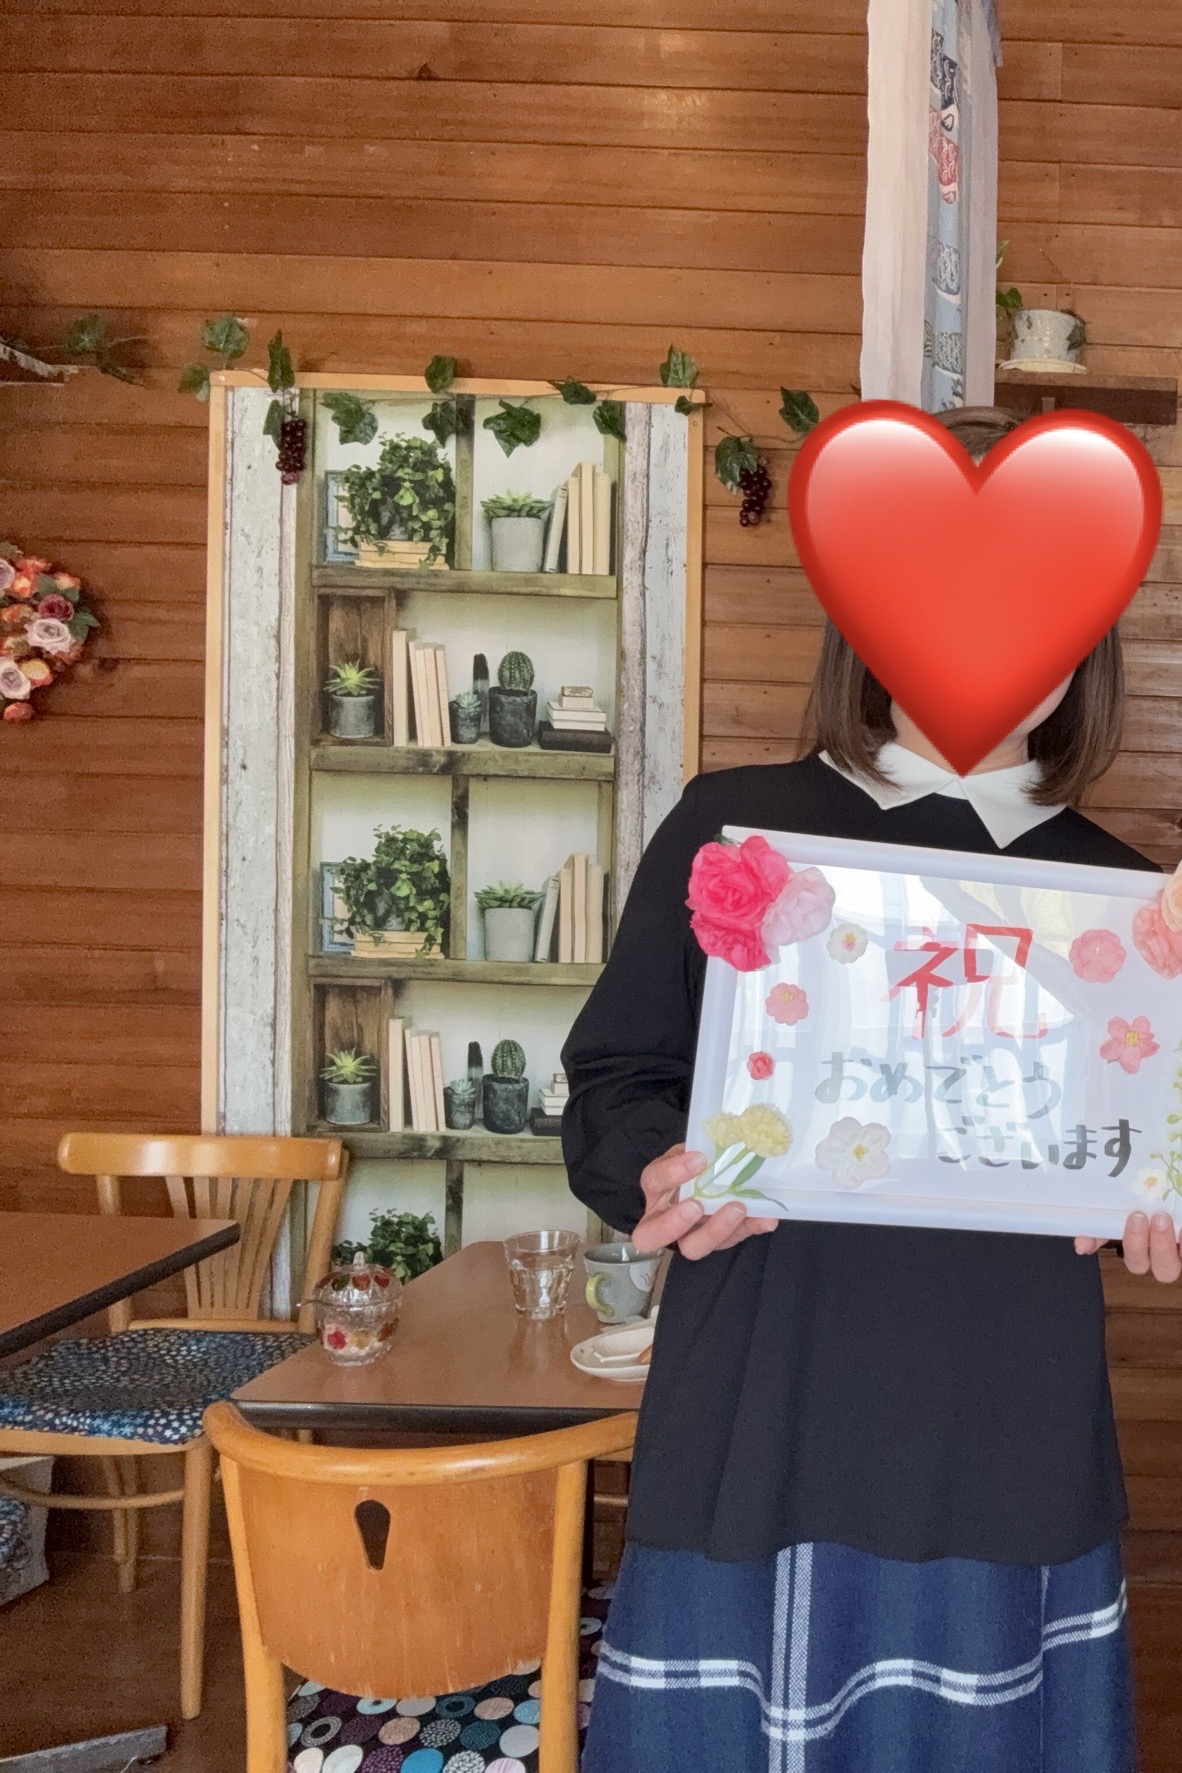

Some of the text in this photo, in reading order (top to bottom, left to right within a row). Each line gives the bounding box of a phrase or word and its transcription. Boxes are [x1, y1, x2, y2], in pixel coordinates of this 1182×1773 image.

[880, 923, 1048, 1039] 祝
[814, 1052, 1061, 1119] おめでとう
[937, 1115, 1142, 1178] ございます
